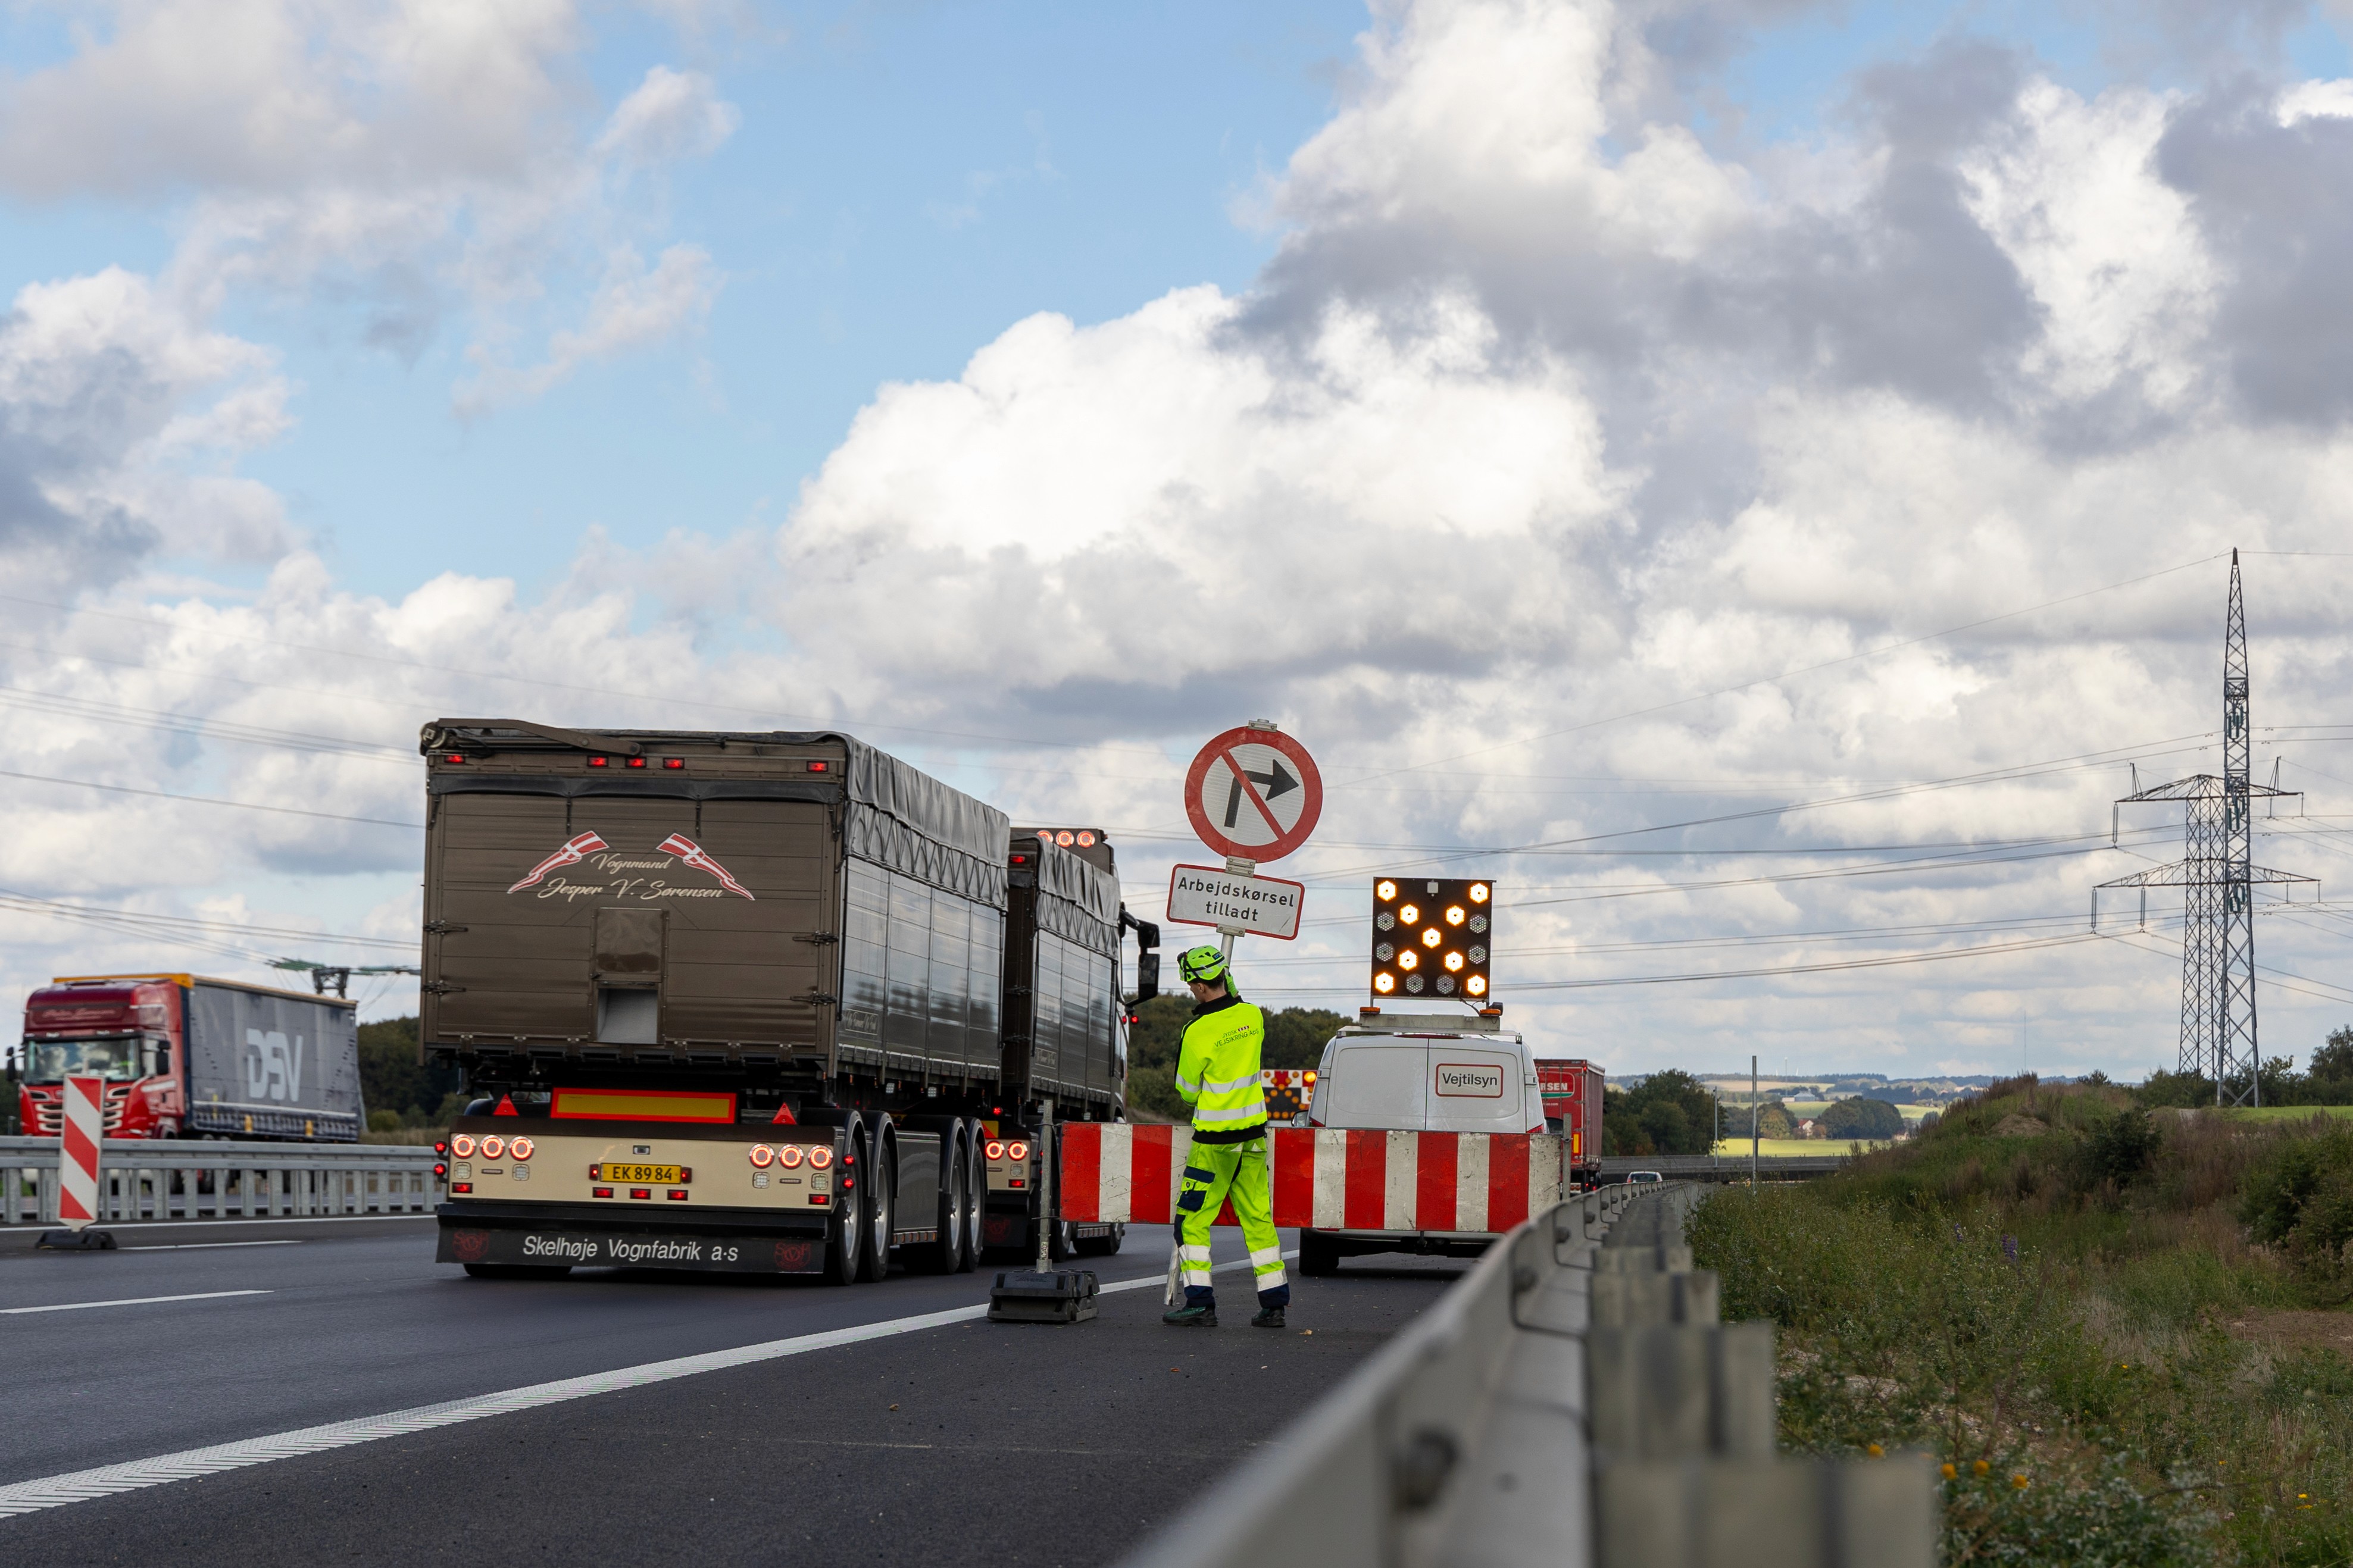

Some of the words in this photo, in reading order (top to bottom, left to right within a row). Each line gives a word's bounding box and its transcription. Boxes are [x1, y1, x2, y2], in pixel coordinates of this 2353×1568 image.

[590, 853, 674, 874] Vognmand
[538, 877, 603, 902] Jesper
[610, 878, 644, 899] V.
[640, 880, 723, 900] Sørensen
[1178, 877, 1293, 907] Arbejdskørsel
[1205, 901, 1258, 921] tilladt
[1214, 1032, 1248, 1047] VEJSIKRING
[246, 1028, 304, 1102] DSV
[1442, 1073, 1498, 1088] Vejtilsyn
[523, 1235, 598, 1261] Skelhøje
[608, 1239, 702, 1262] Vognfabrik
